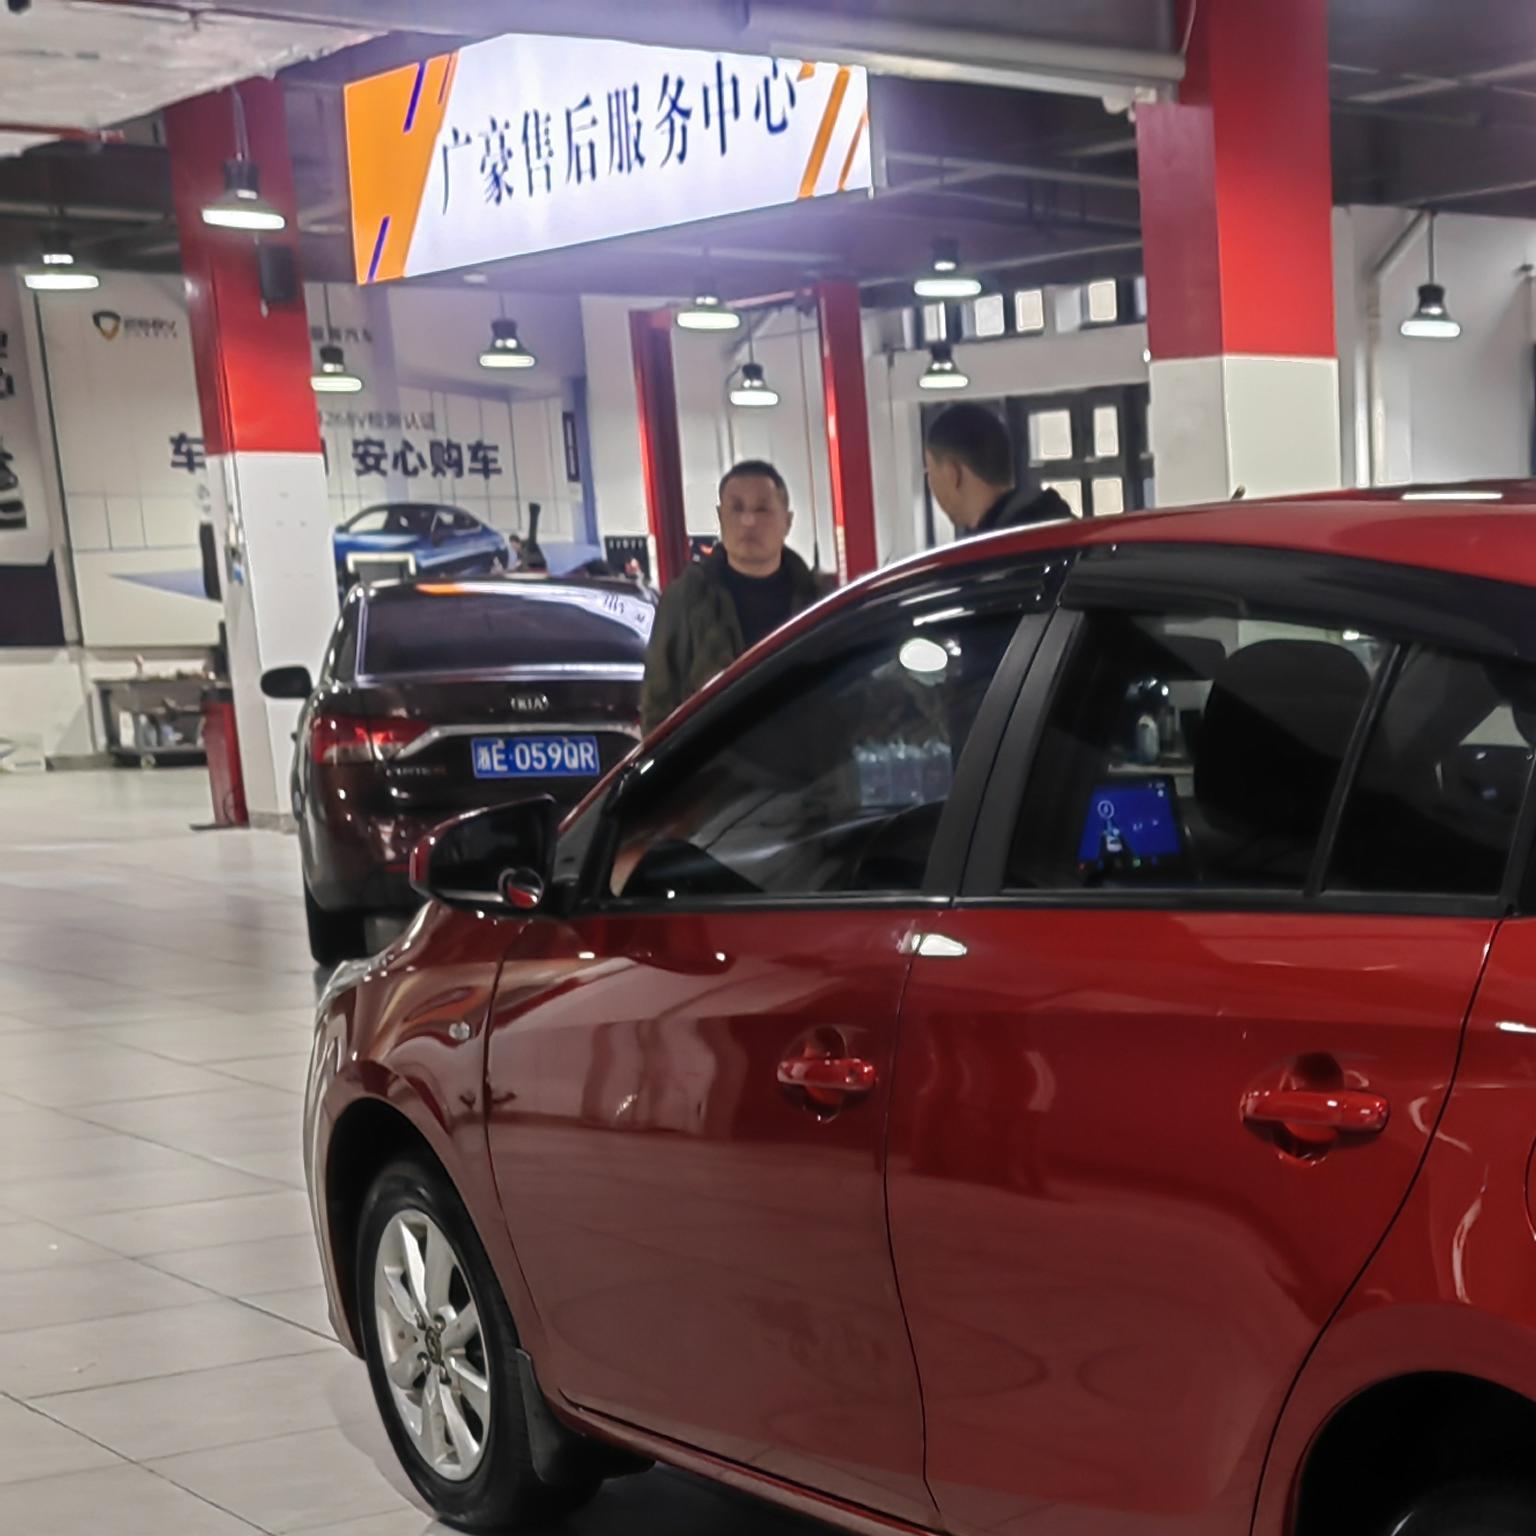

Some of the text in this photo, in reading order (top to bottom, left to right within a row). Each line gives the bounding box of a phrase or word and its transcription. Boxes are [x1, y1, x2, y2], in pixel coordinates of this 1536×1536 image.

[442, 56, 796, 216] 广豪售后服务中心
[352, 438, 503, 480] 安心购车
[515, 697, 545, 711] KIA
